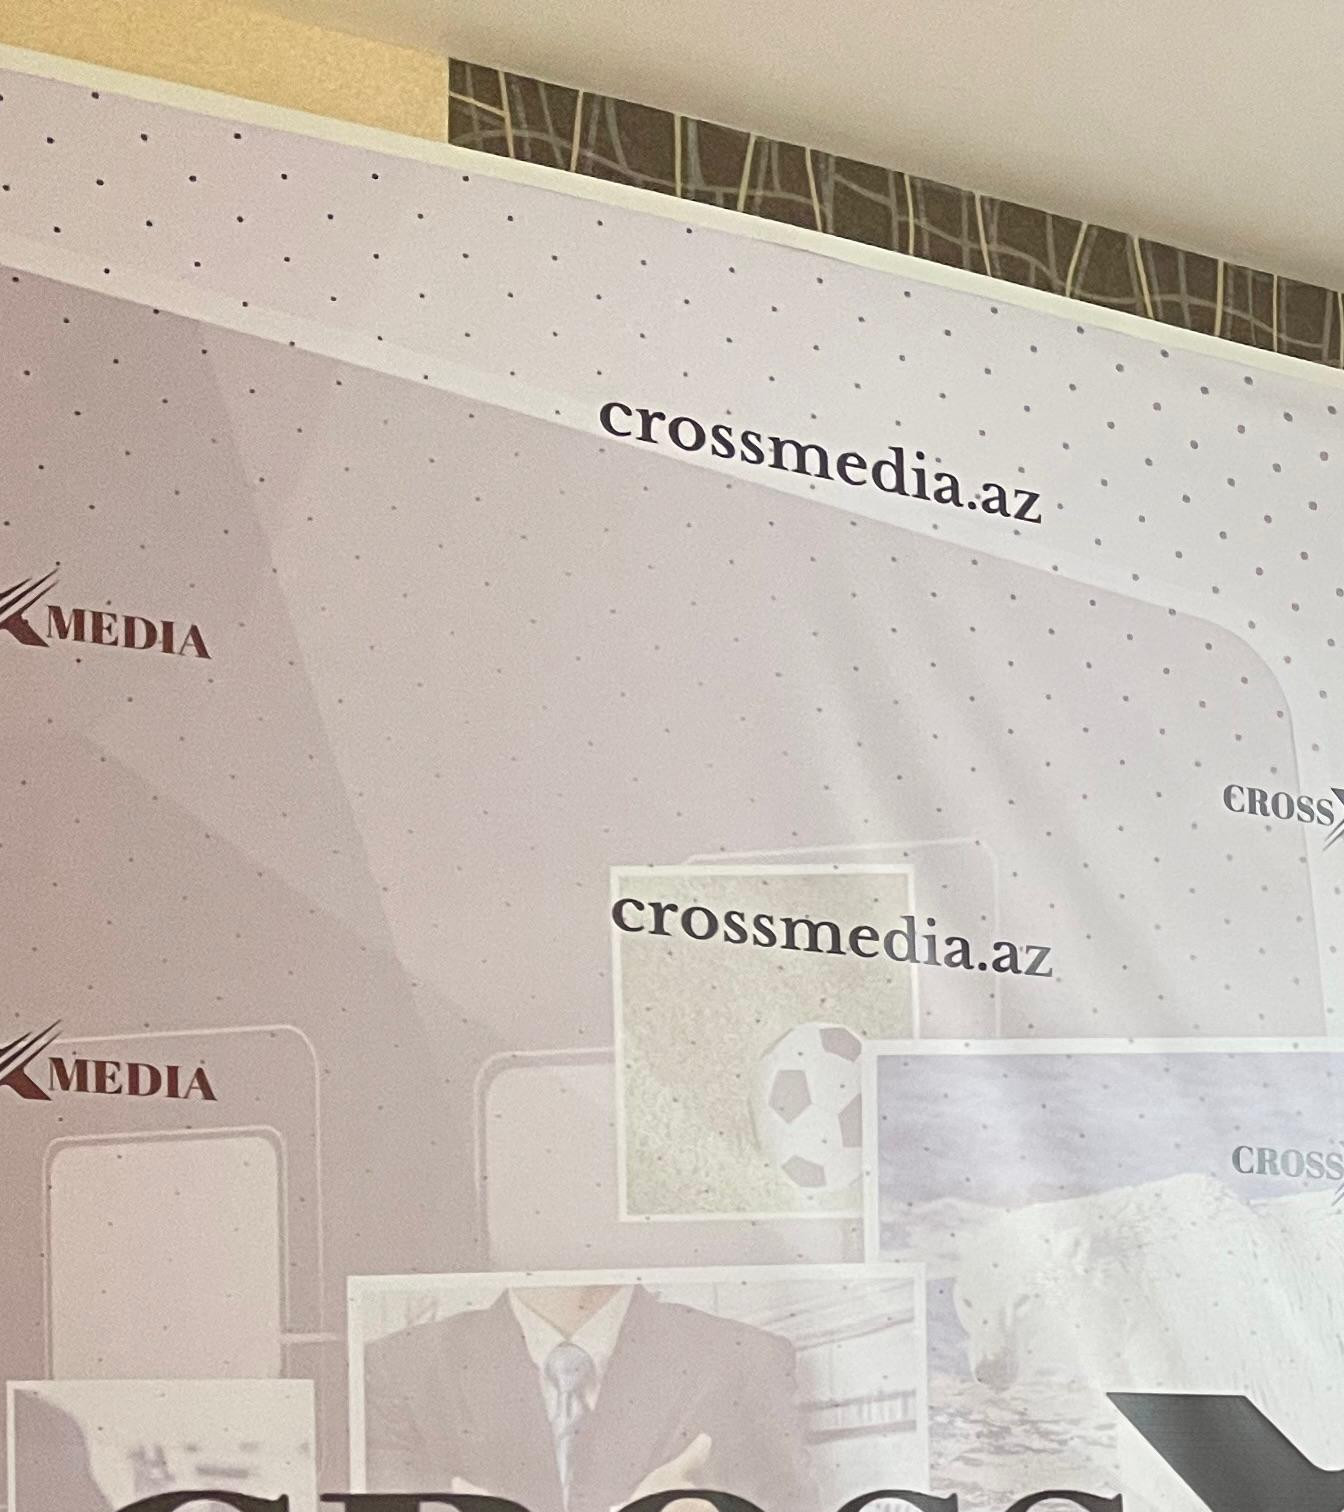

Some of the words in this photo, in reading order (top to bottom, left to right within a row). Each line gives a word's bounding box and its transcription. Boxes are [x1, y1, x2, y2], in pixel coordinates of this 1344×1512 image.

[600, 400, 1042, 523] crossmedia.az
[45, 606, 211, 659] MEDIA
[611, 896, 1053, 978] crossmedia.az
[47, 1057, 217, 1101] MEDIA
